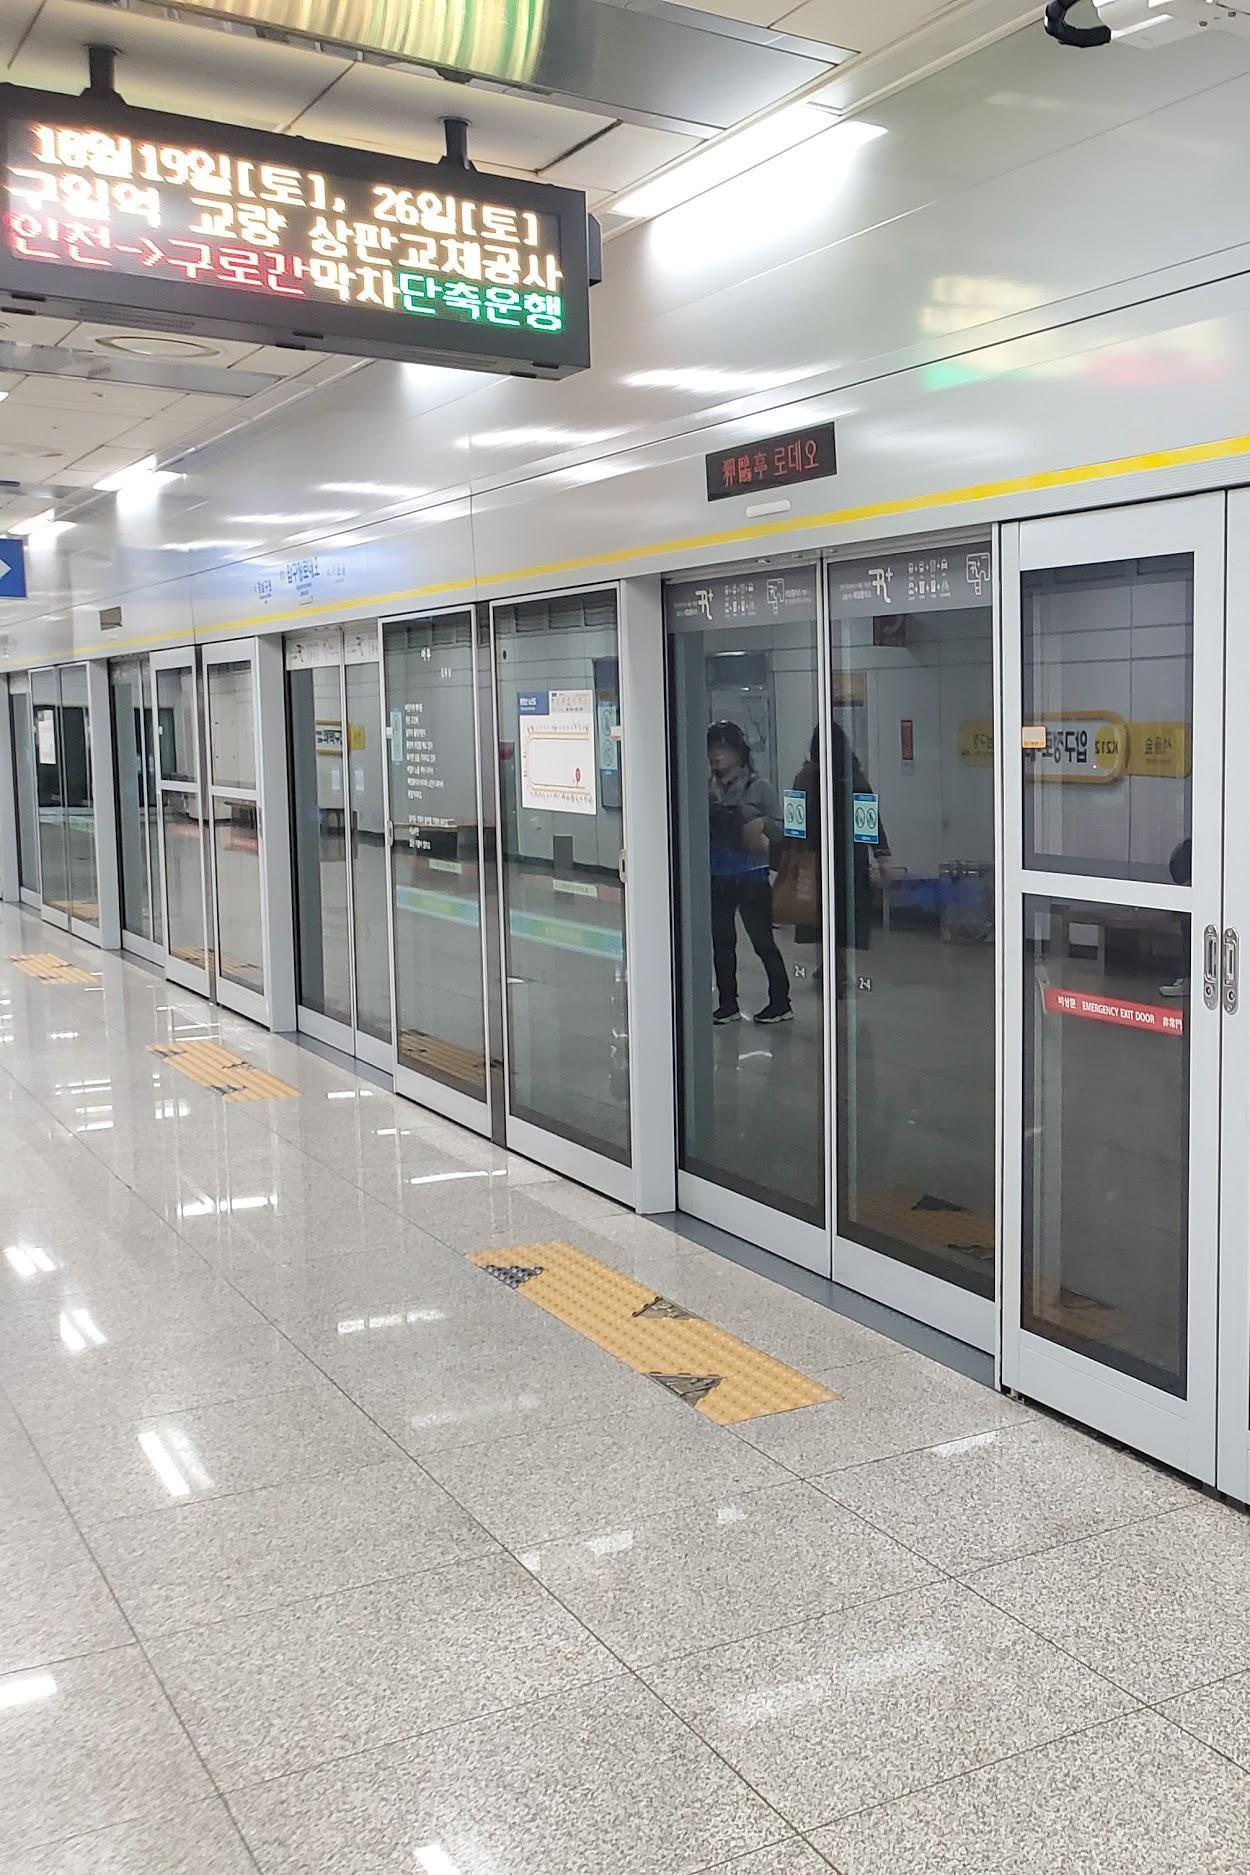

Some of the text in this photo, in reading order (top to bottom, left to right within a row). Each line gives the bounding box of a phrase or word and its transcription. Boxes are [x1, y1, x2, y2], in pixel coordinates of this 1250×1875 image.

[2, 165, 162, 229] 구일역
[188, 196, 289, 247] 교량
[773, 439, 819, 476] 로데오
[1057, 995, 1183, 1031] 비상문 EMERGENCY EXIT DOOR 非常門
